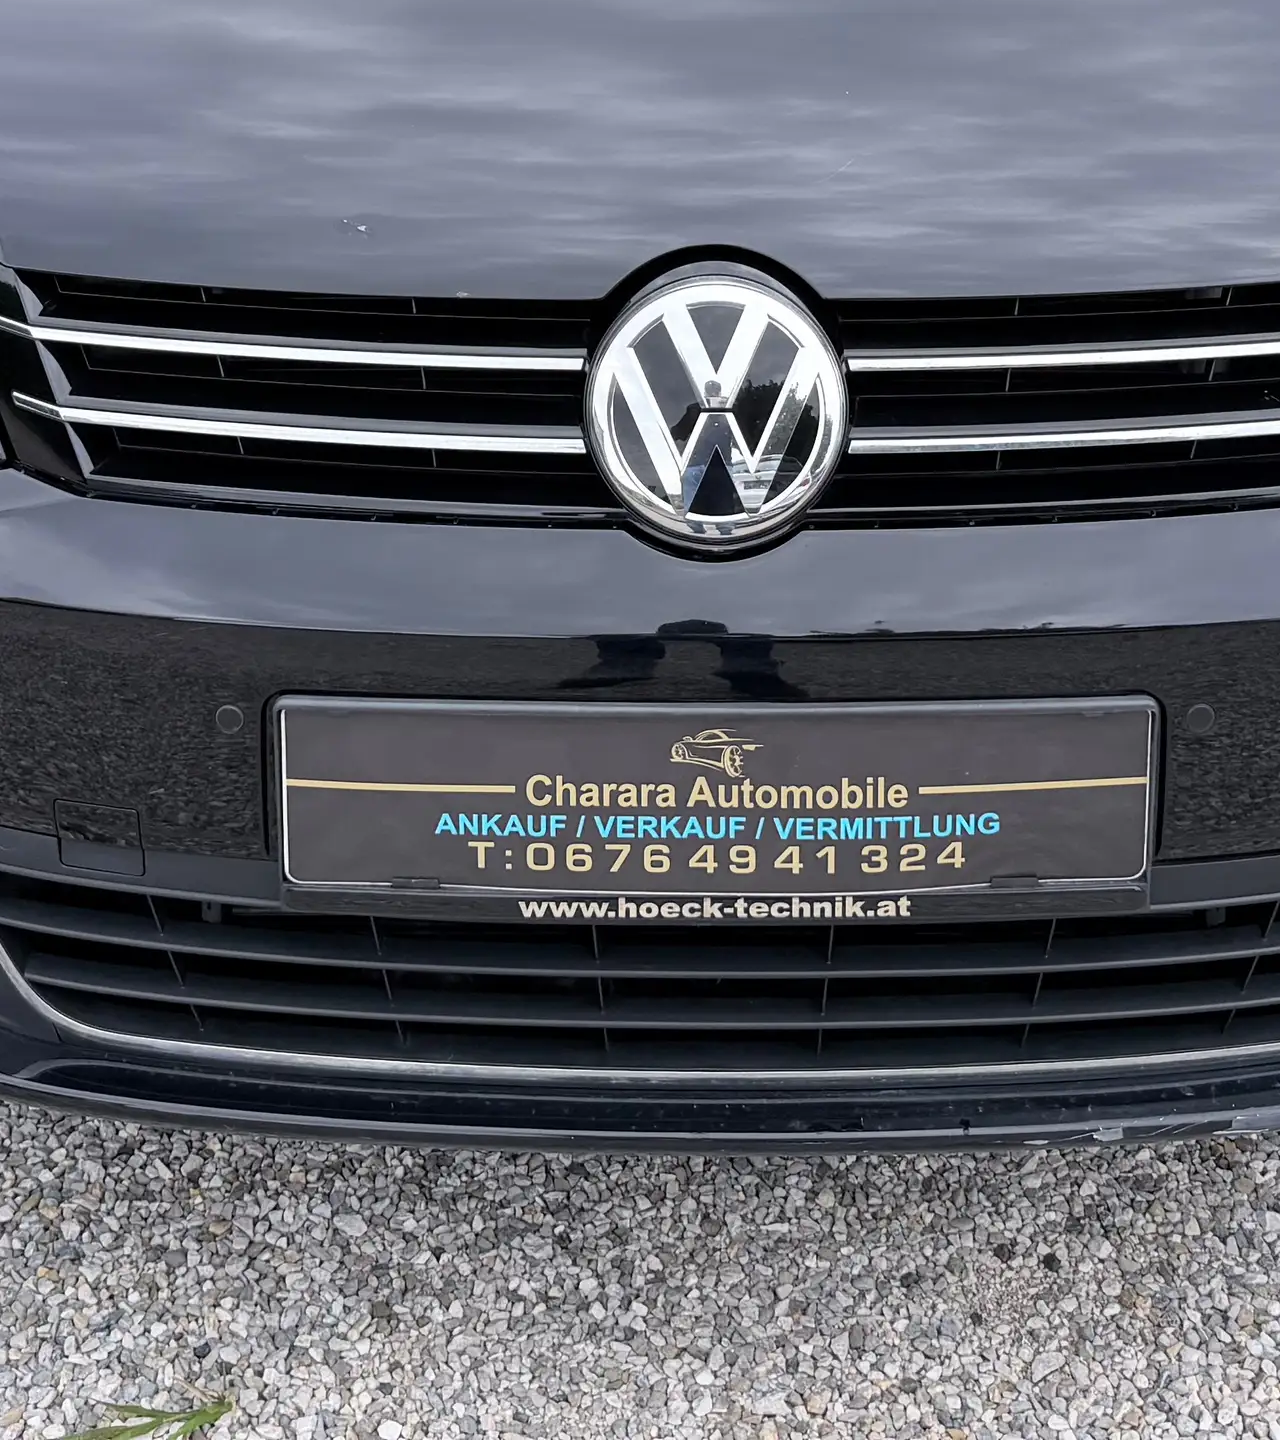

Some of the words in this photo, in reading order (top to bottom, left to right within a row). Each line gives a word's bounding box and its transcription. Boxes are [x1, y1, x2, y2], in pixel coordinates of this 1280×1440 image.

[588, 276, 844, 538] VW
[525, 774, 676, 808] Charara
[686, 775, 909, 810] Automobile
[434, 813, 567, 838] ANKAUF
[593, 815, 747, 839] VERKAUF
[773, 812, 1001, 841] VERMITTLUNG
[688, 844, 757, 874] 49
[773, 845, 837, 875] 41
[860, 841, 966, 874] 324
[518, 895, 912, 919] www.hoeck-technik.at
